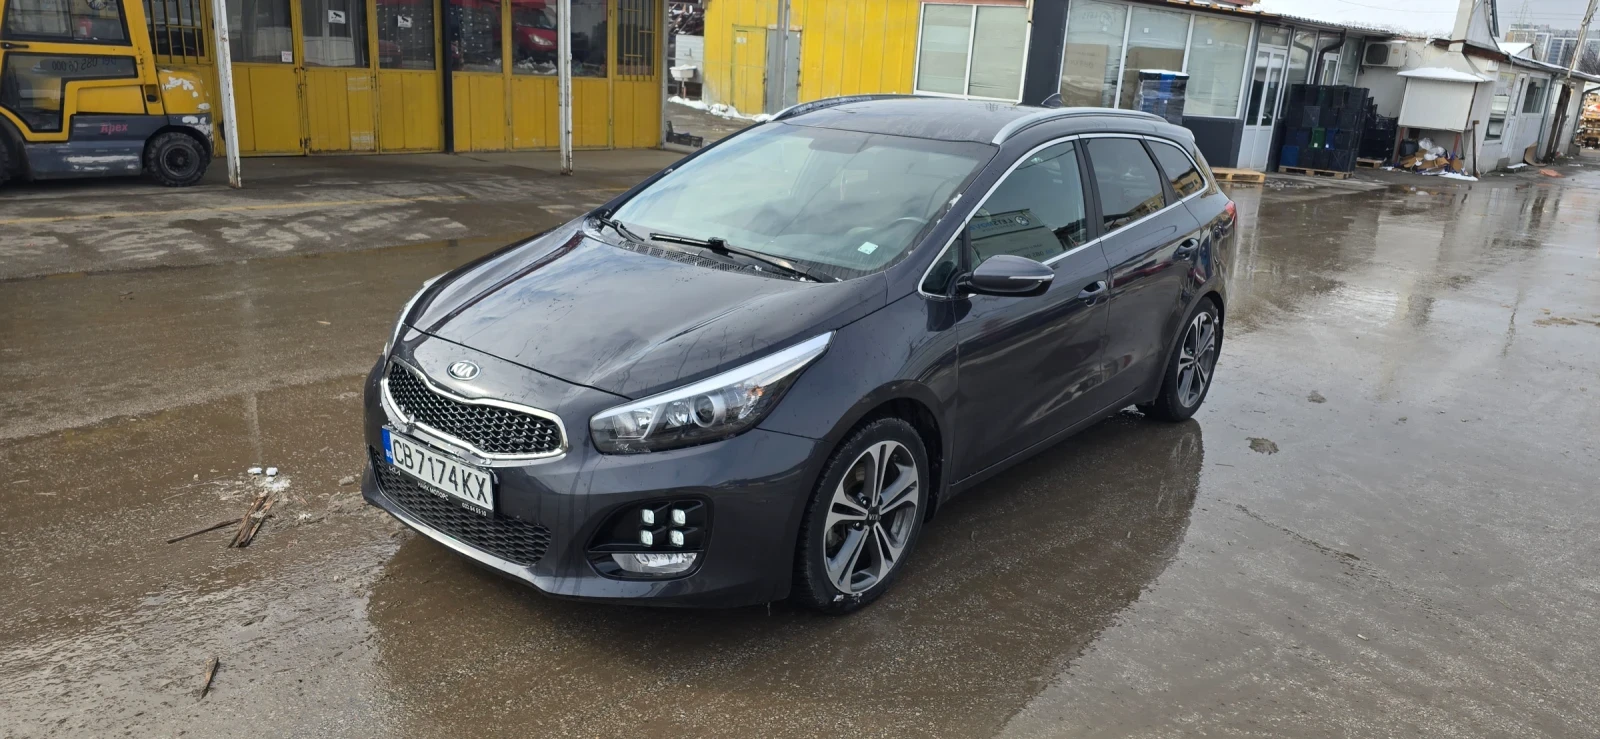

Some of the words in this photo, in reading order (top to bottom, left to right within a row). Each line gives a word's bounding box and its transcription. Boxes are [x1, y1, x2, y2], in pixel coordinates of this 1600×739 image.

[101, 123, 128, 135] Apex
[450, 362, 475, 378] KIA
[393, 439, 488, 504] CB7174KX
